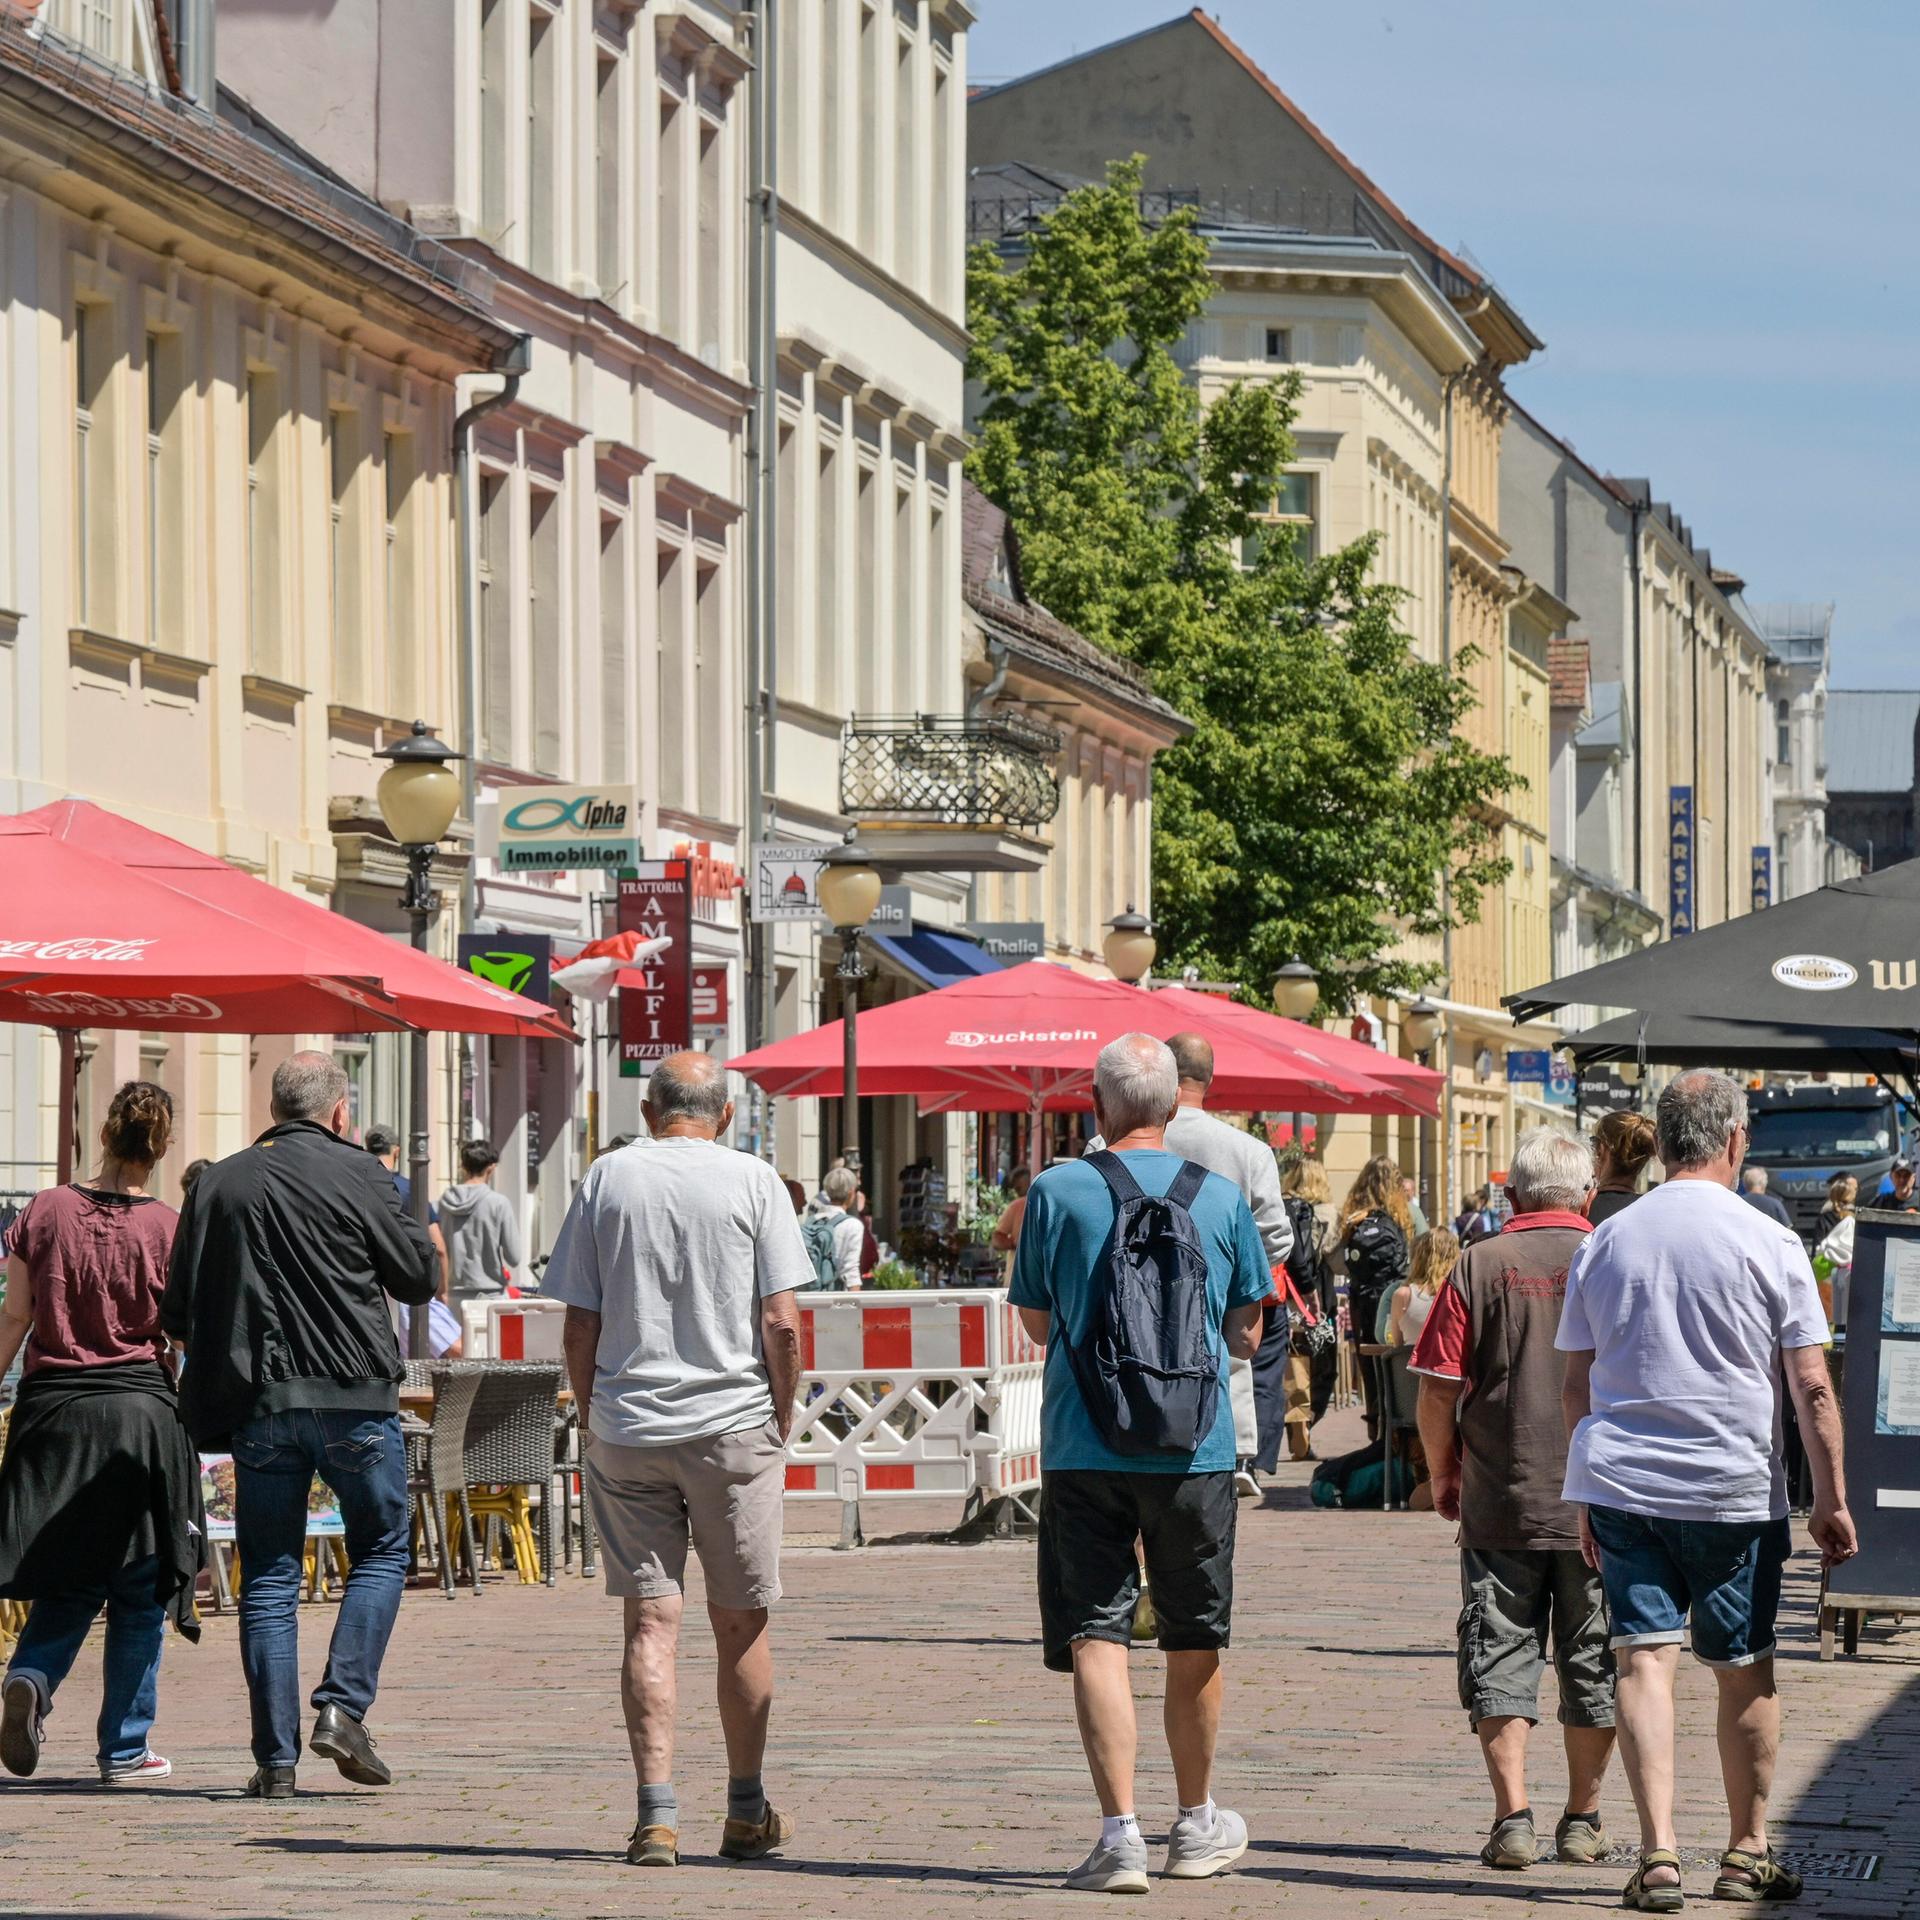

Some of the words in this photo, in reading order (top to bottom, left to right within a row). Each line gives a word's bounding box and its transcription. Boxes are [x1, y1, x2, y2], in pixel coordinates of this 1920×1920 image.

[507, 846, 628, 864] Immobilien
[1671, 798, 1690, 938] KARSTA
[621, 881, 684, 894] TRATTORIA
[987, 938, 1038, 953] Thalia
[639, 896, 668, 1040] AMALFI
[1781, 966, 1849, 979] Warsteiner
[946, 1029, 1098, 1047] Duckstein
